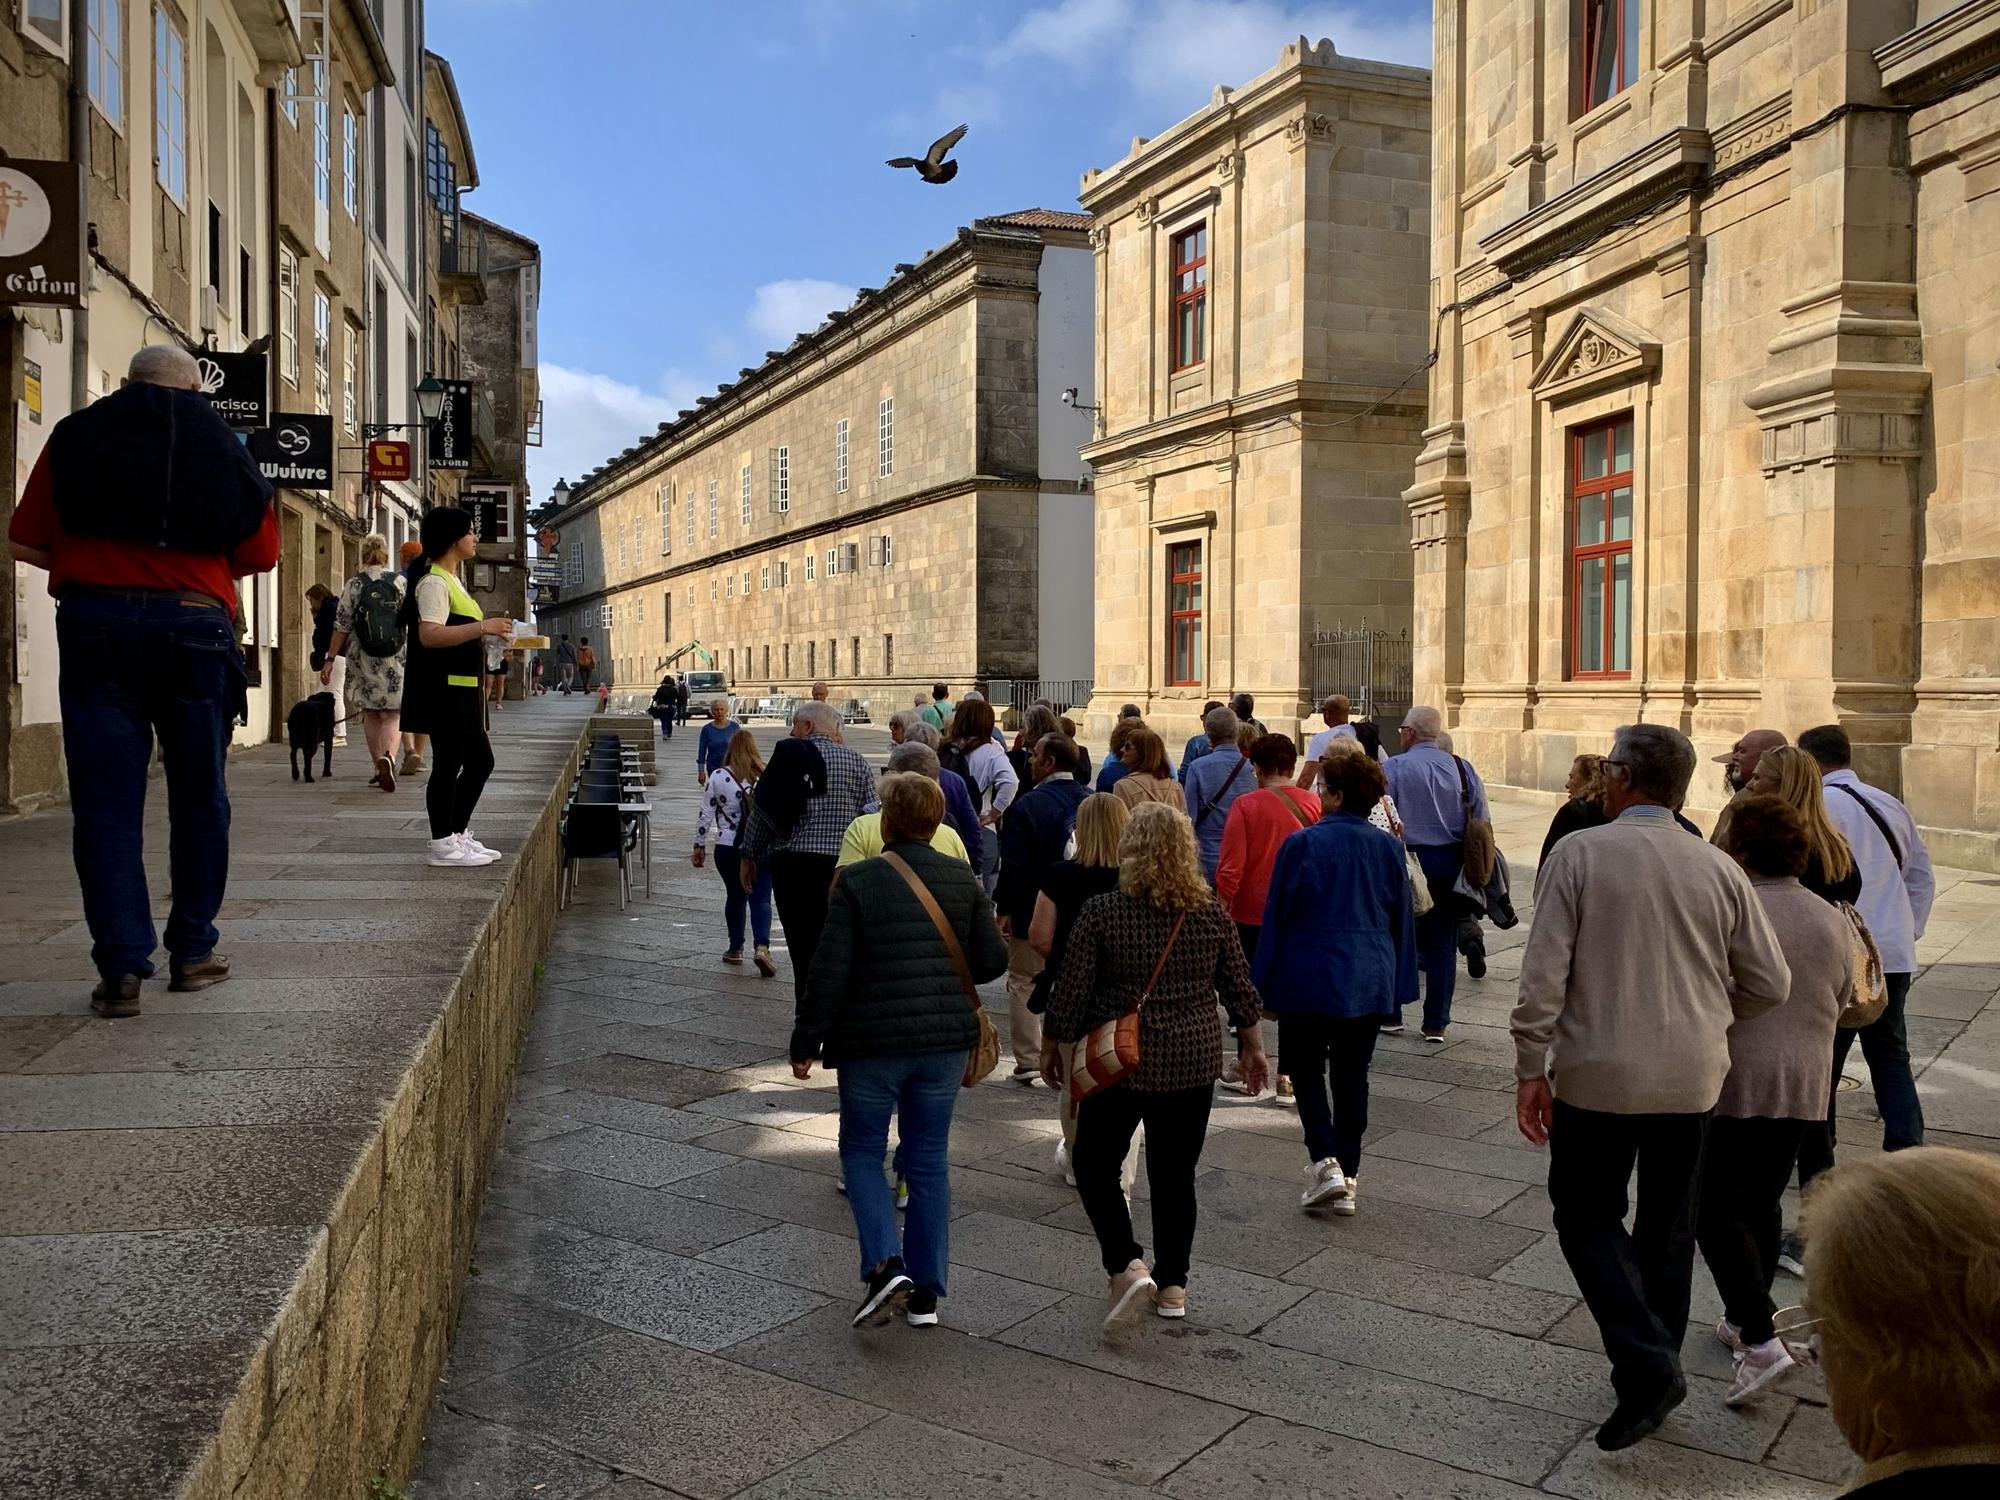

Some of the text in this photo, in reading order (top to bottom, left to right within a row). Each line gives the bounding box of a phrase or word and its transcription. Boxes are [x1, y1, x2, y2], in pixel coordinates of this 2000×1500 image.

[6, 273, 76, 296] Coton
[210, 398, 259, 411] ncisco
[444, 394, 454, 458] HABITACIONES
[260, 462, 327, 480] Wuivre
[429, 459, 469, 467] OXFORD
